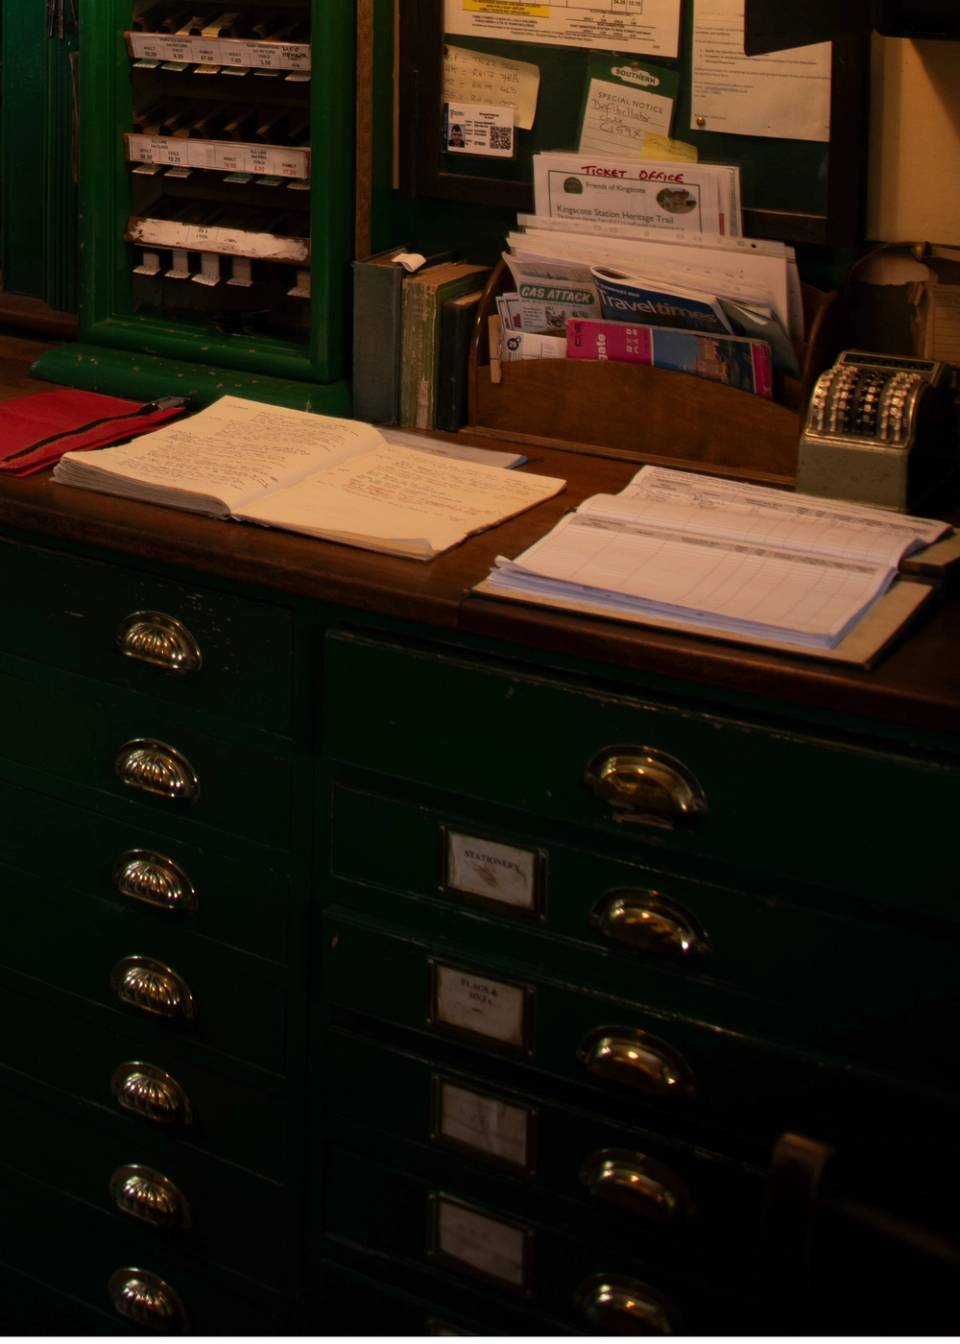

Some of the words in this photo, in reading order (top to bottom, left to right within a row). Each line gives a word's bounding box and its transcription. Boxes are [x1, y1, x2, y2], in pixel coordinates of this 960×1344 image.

[615, 67, 657, 84] SOUTHERN
[598, 91, 630, 106] SPECIAL
[632, 99, 663, 115] NOTICE
[581, 165, 627, 178] TICKET
[638, 169, 685, 184] OFFICE
[586, 181, 608, 191] Friends
[608, 183, 616, 191] of
[594, 208, 620, 218] Station
[622, 211, 655, 223] Heritage
[656, 215, 674, 224] Trail
[520, 286, 548, 300] GAS
[549, 288, 591, 304] ATTACK
[464, 849, 521, 872] STATIONERY
